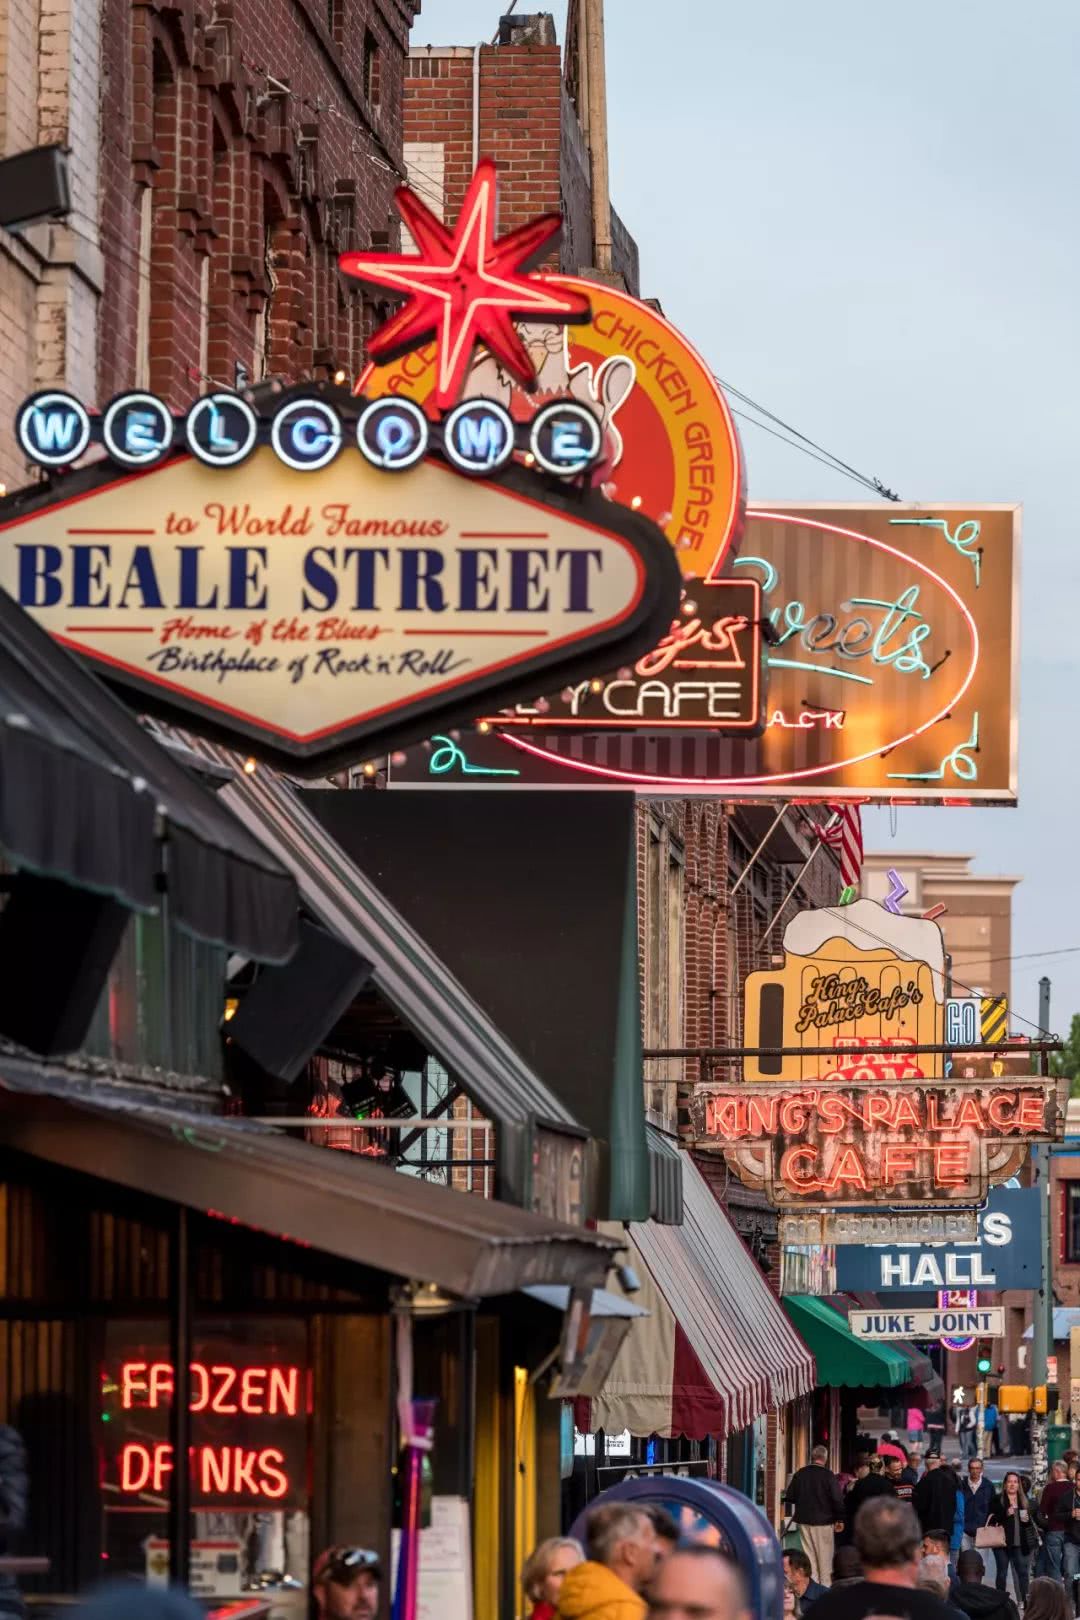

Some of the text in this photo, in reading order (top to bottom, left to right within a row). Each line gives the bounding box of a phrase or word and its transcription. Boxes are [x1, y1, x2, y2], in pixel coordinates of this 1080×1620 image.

[28, 404, 594, 468] WELCOME
[592, 310, 715, 551] CHICKEN GREASE
[165, 502, 449, 538] to World Famous
[14, 543, 602, 613] BEALE STREET
[159, 616, 393, 646] Home of the Blues
[146, 645, 280, 684] Birthplace
[287, 653, 309, 684] of
[603, 679, 742, 718] CAFE
[766, 710, 845, 729] ACK
[795, 980, 923, 1033] Palace Cafe's
[805, 973, 869, 1005] Kings
[946, 1001, 976, 1045] GO
[833, 1037, 917, 1071] TAP
[707, 1089, 1045, 1136] KING'S PALACE
[781, 1140, 970, 1194] CAFE
[880, 1252, 996, 1287] HALL
[861, 1312, 993, 1334] JUKE JOINT
